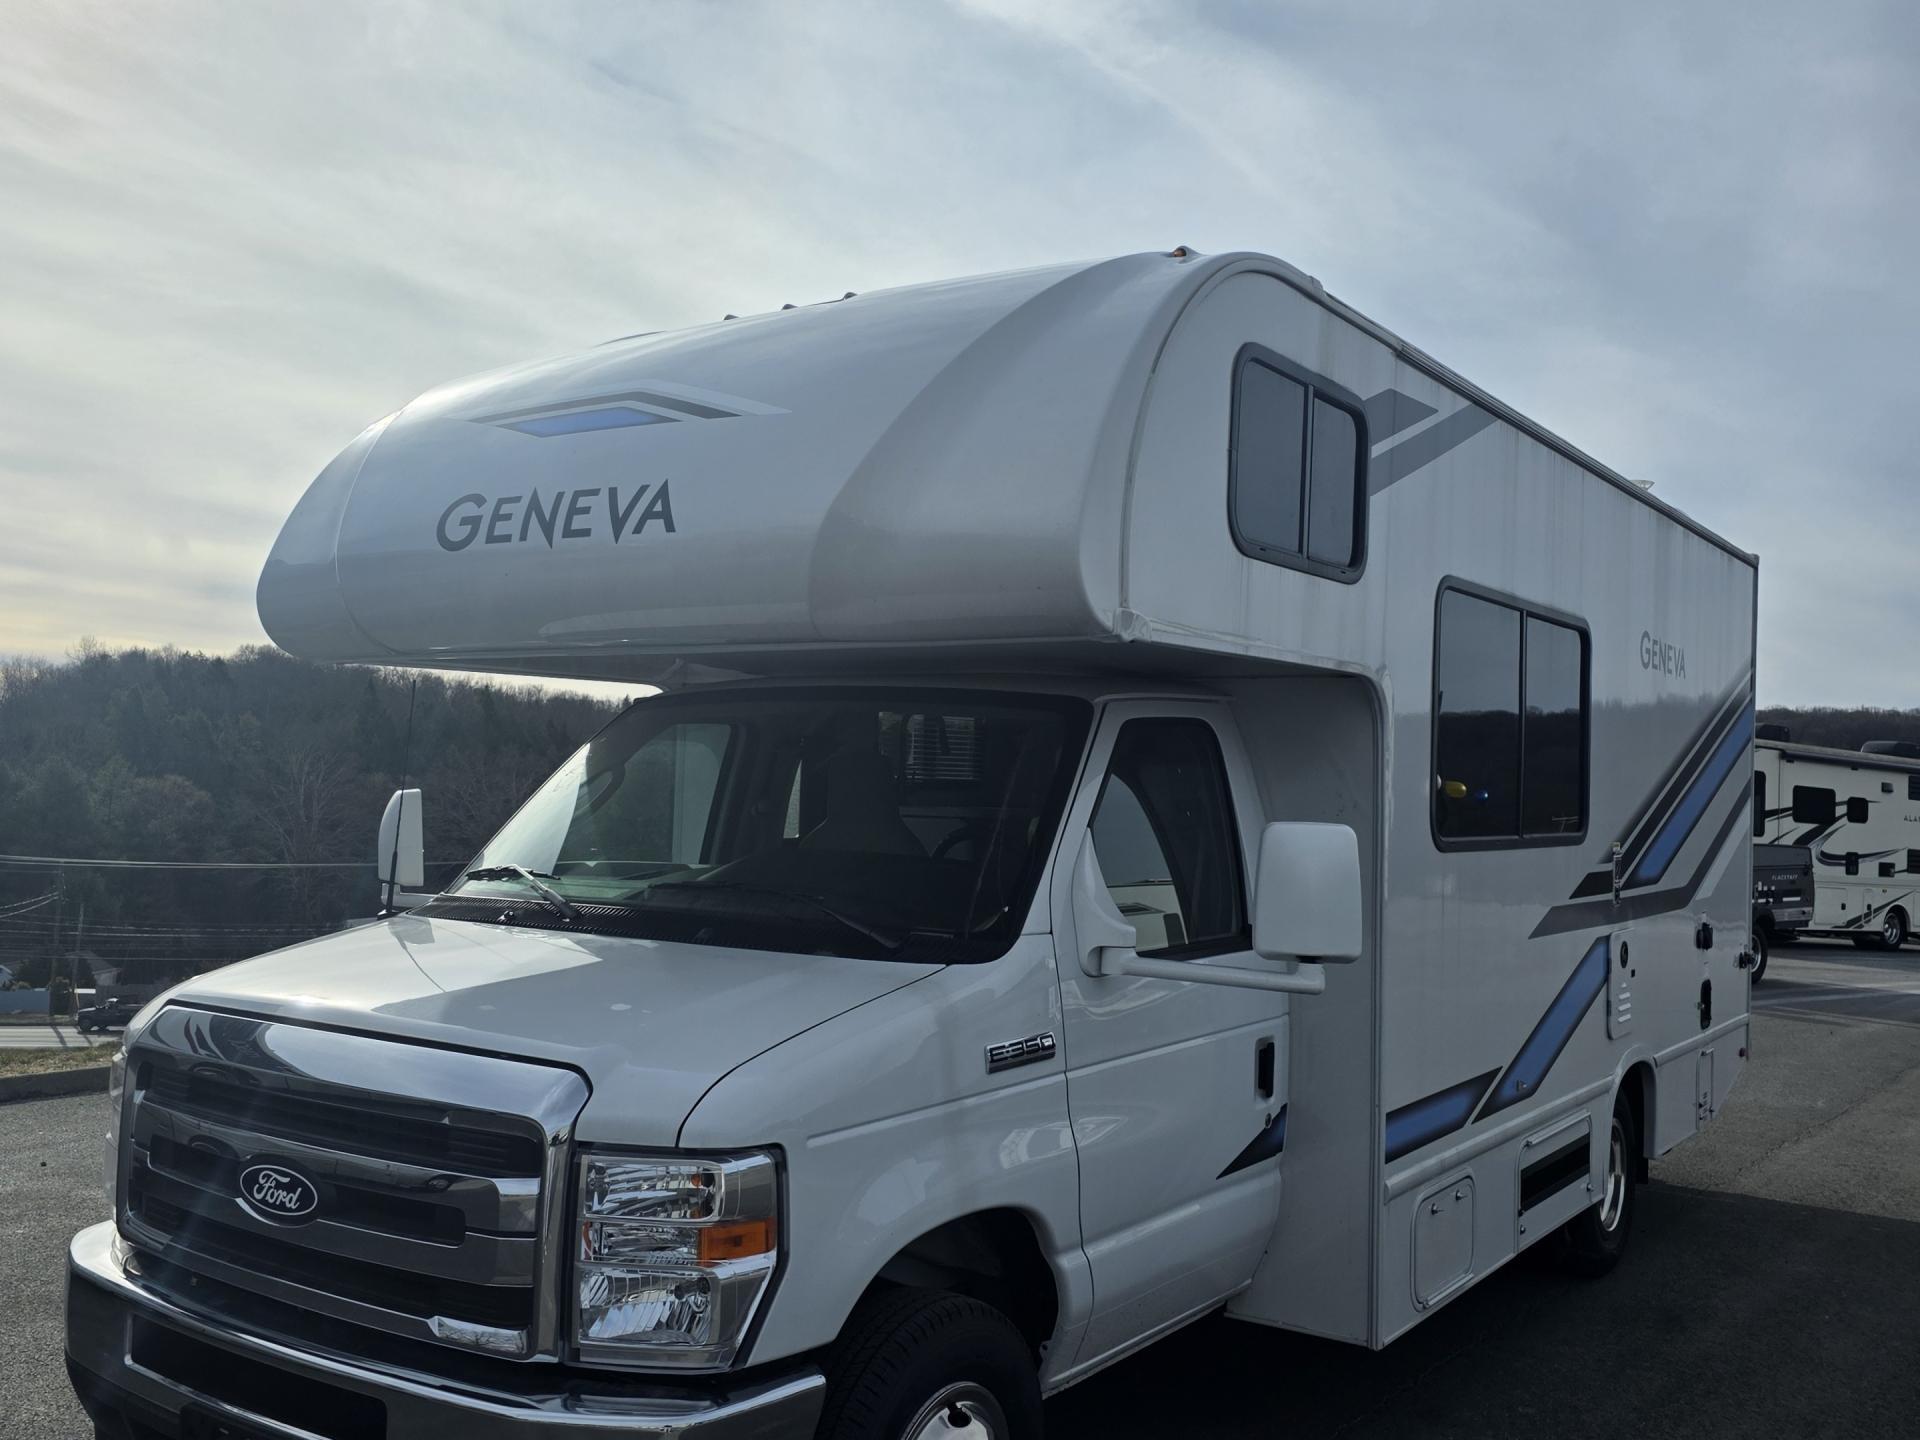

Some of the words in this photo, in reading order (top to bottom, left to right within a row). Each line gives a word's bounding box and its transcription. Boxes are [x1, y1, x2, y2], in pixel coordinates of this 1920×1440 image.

[436, 478, 676, 552] GENEVA
[1640, 630, 1686, 680] GENEVA
[253, 1170, 302, 1209] Ford
